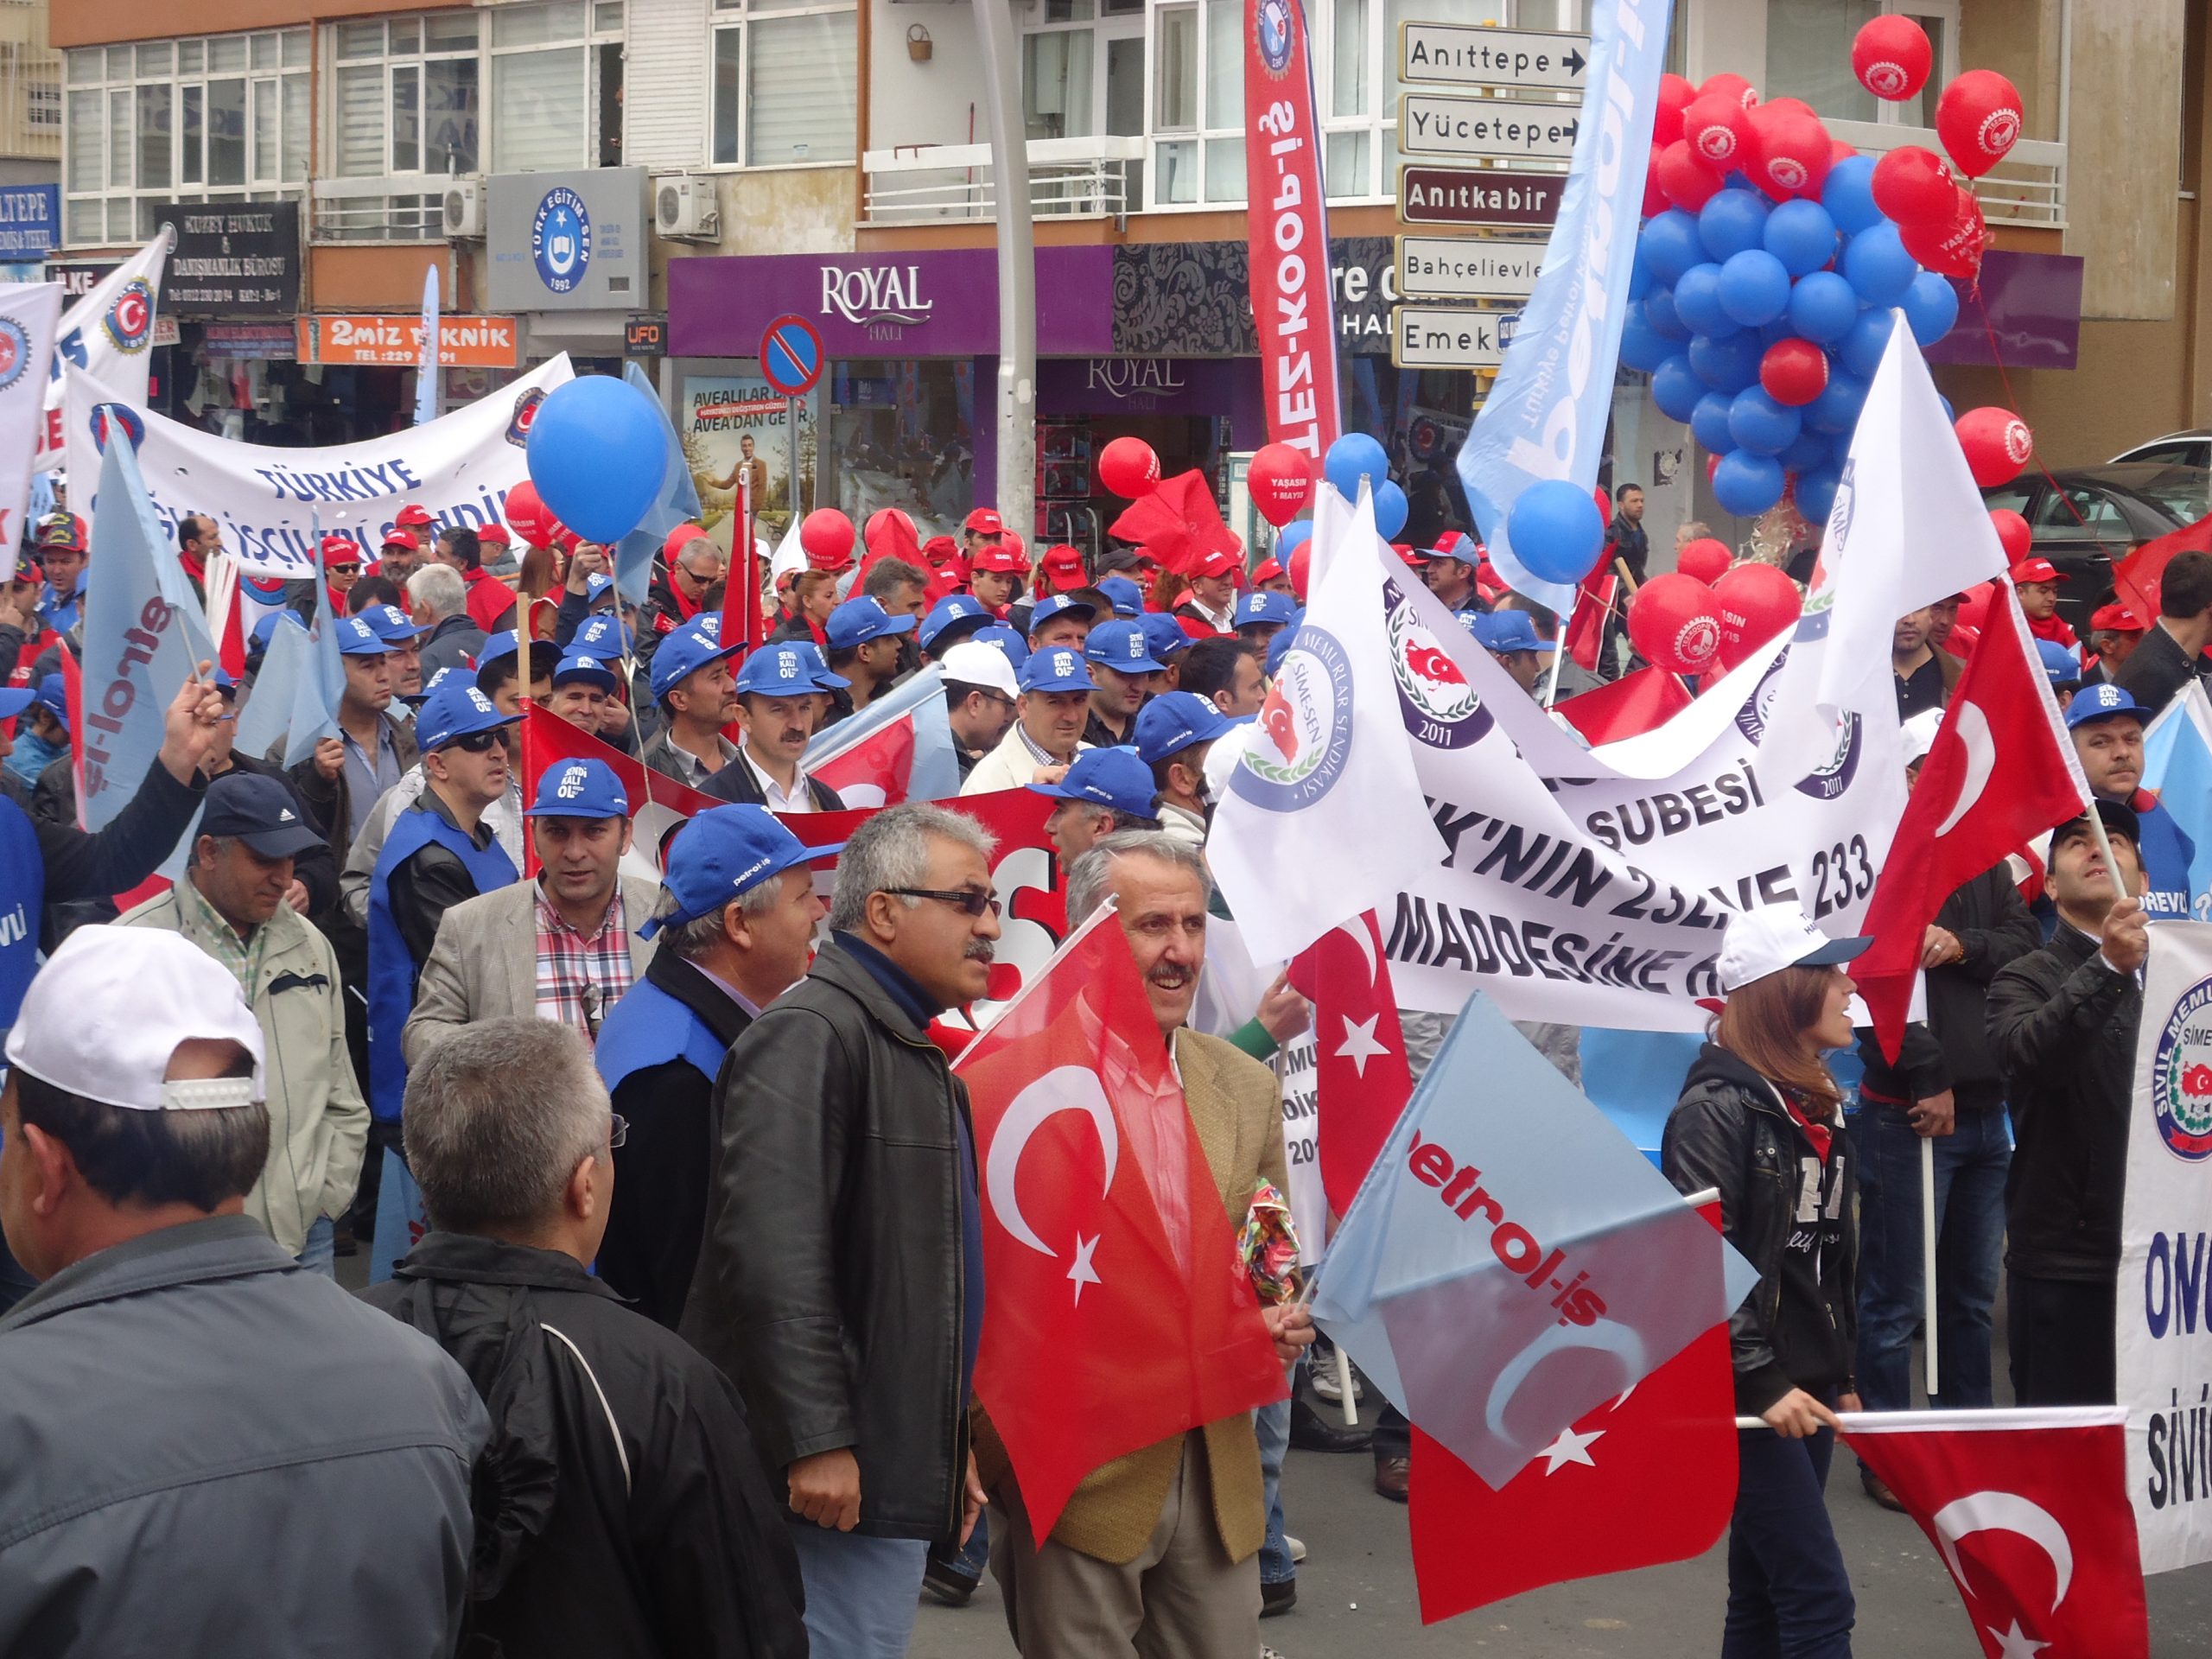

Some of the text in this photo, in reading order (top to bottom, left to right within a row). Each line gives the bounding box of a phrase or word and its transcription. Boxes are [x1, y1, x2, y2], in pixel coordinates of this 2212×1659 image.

[1410, 40, 1550, 81] Anıttepe
[1412, 111, 1562, 149] Yücetepe
[1408, 183, 1547, 212] Anıtkabir
[532, 210, 548, 259] TÜRK
[547, 188, 591, 263] EĞİTİM-SEN
[550, 278, 570, 290] 1992
[820, 266, 932, 323] ROYAL
[410, 320, 511, 347] TKNİK
[628, 326, 659, 344] UFO
[1405, 325, 1491, 351] Emek
[354, 350, 378, 361] TEL
[440, 353, 456, 362] 91
[693, 386, 769, 407] AVEALILAR
[693, 409, 808, 433] AVEA'DAN GER
[254, 458, 423, 502] TÜRKİYE
[1272, 478, 1307, 489] YAŞASIN
[779, 658, 795, 668] KALI
[779, 668, 795, 678] OL
[1292, 662, 1323, 744] SİME-SEN
[1418, 720, 1453, 747] 2011
[1302, 715, 1348, 798] SENDİKASI
[561, 776, 581, 785] KALI
[564, 766, 588, 778] SENDİ
[557, 785, 575, 799] OL
[1821, 776, 1843, 798] 2011
[1386, 891, 1694, 995] MADDESİNE
[2155, 1046, 2173, 1118] SİVİL
[2148, 1382, 2212, 1510] SİVİ
